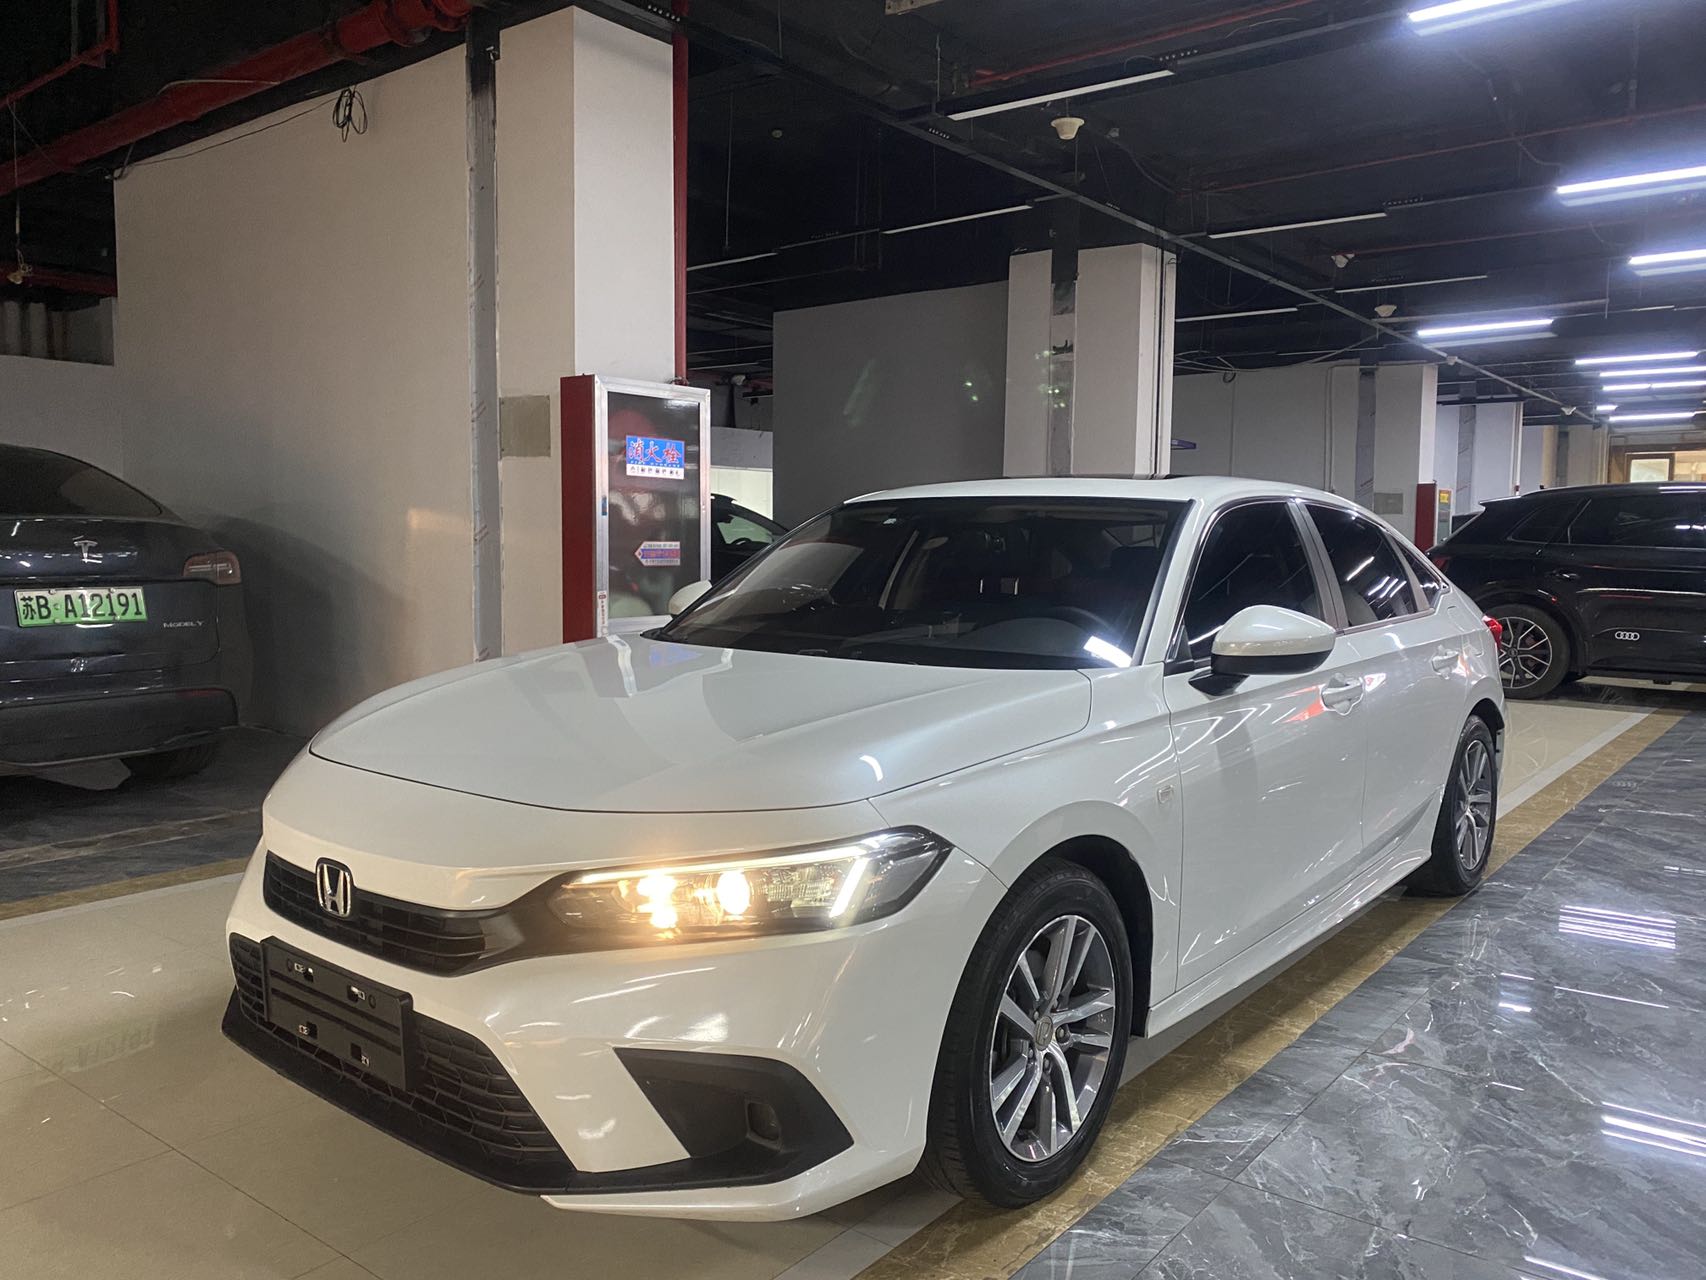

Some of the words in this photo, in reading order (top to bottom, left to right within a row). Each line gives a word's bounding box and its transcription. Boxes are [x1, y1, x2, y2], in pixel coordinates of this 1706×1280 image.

[628, 439, 681, 463] 消火栓
[64, 593, 142, 618] A12191
